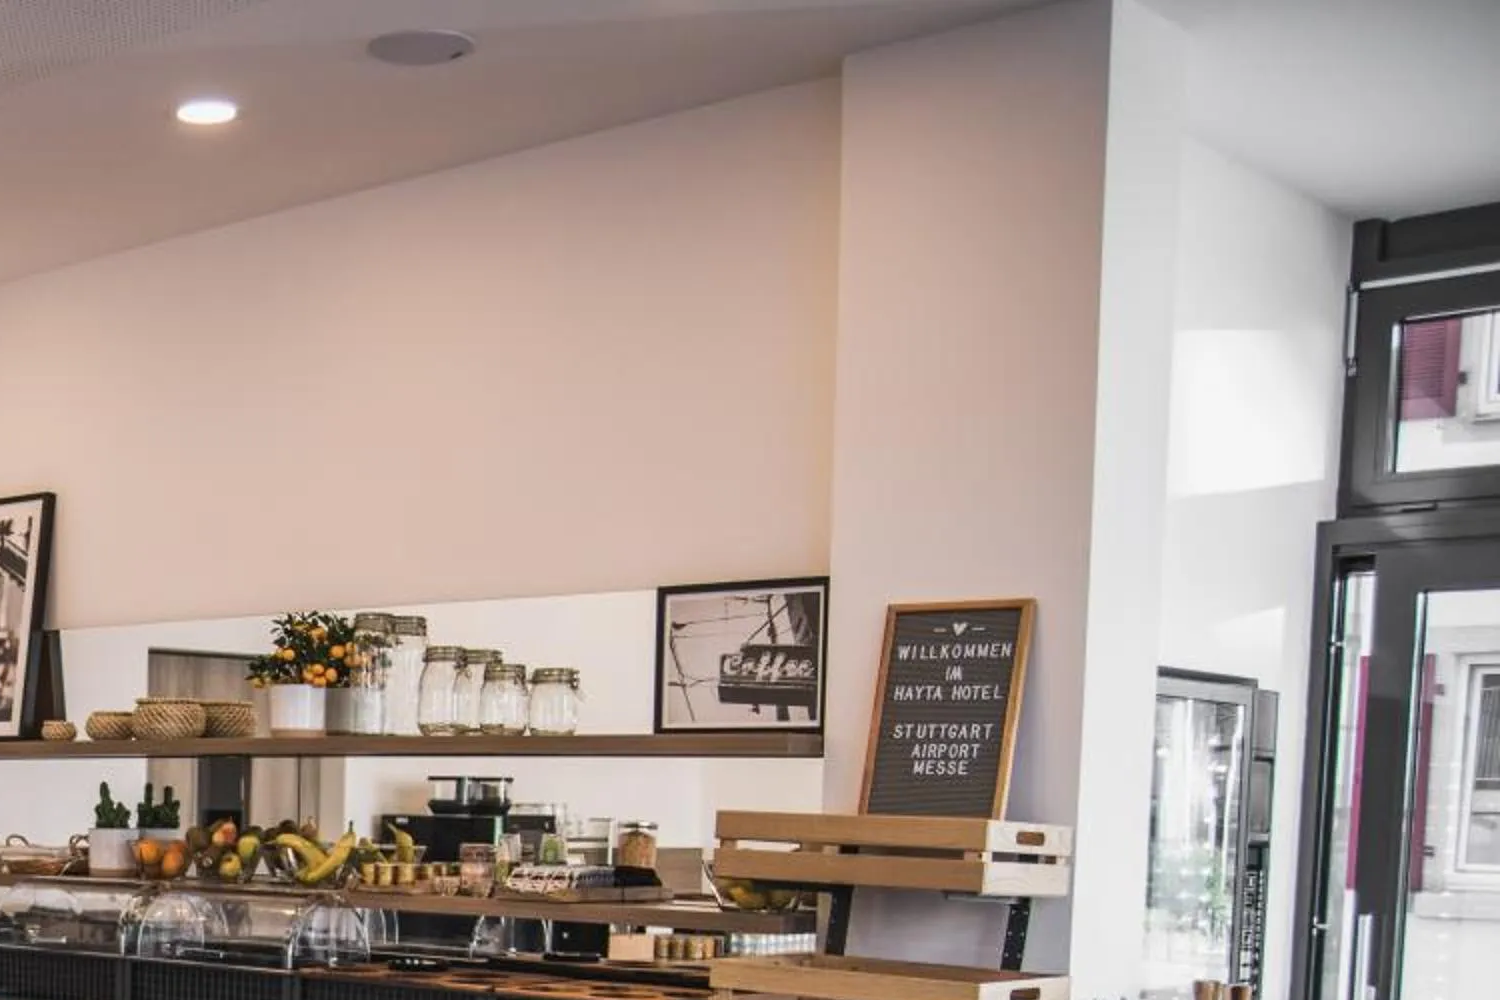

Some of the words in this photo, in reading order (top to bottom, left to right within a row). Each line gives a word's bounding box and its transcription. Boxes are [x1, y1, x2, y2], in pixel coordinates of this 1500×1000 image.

[898, 643, 1013, 660] WILLKOMMEN
[723, 652, 814, 682] Coffee
[945, 665, 963, 681] IM
[893, 685, 943, 701] HAYTA
[951, 684, 1004, 700] HOTEL
[892, 723, 994, 740] STUTTGART
[911, 744, 981, 760] AIRPORT
[913, 760, 969, 776] MESSE
